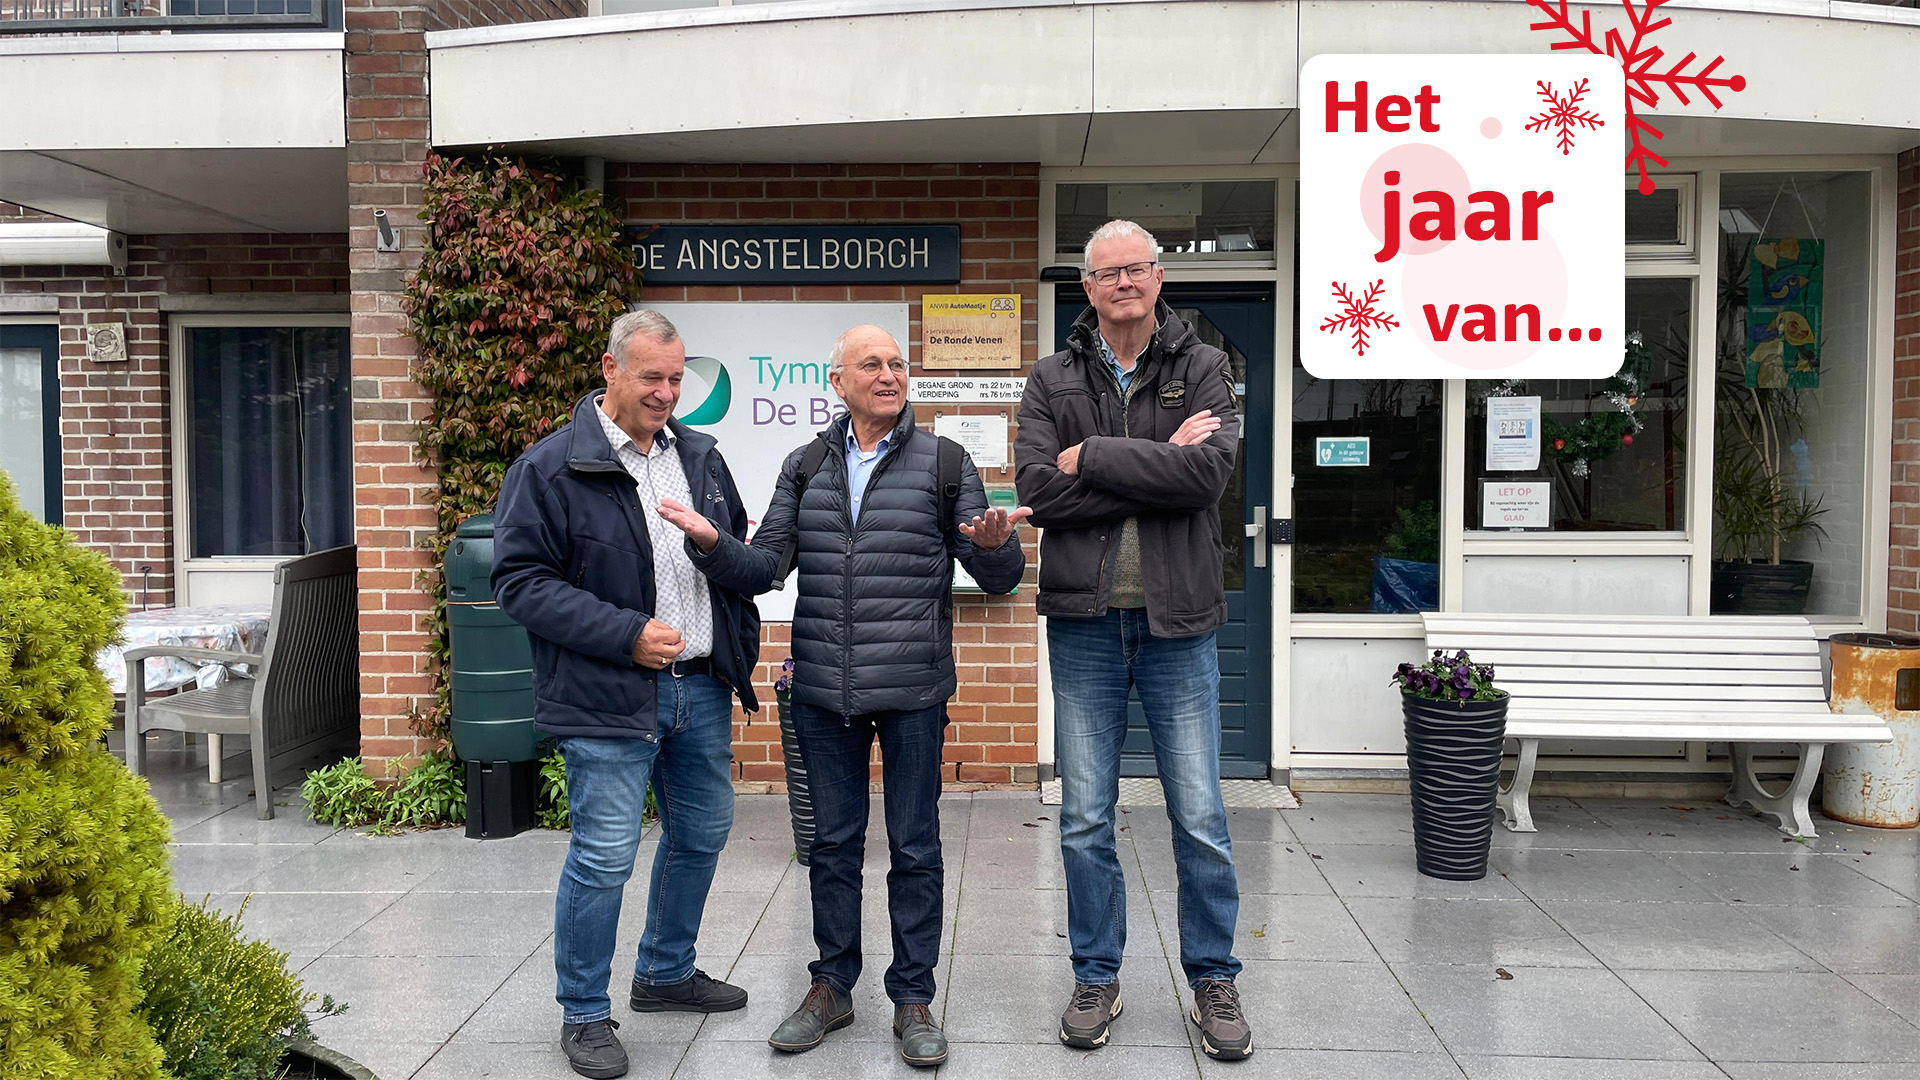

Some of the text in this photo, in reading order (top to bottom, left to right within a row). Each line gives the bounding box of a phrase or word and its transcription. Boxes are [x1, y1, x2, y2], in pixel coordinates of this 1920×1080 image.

[631, 238, 929, 271] DE ANGSTELBORGH
[929, 336, 1003, 345] De Ronde Venen
[753, 397, 797, 426] De
[1498, 488, 1532, 496] LET OP
